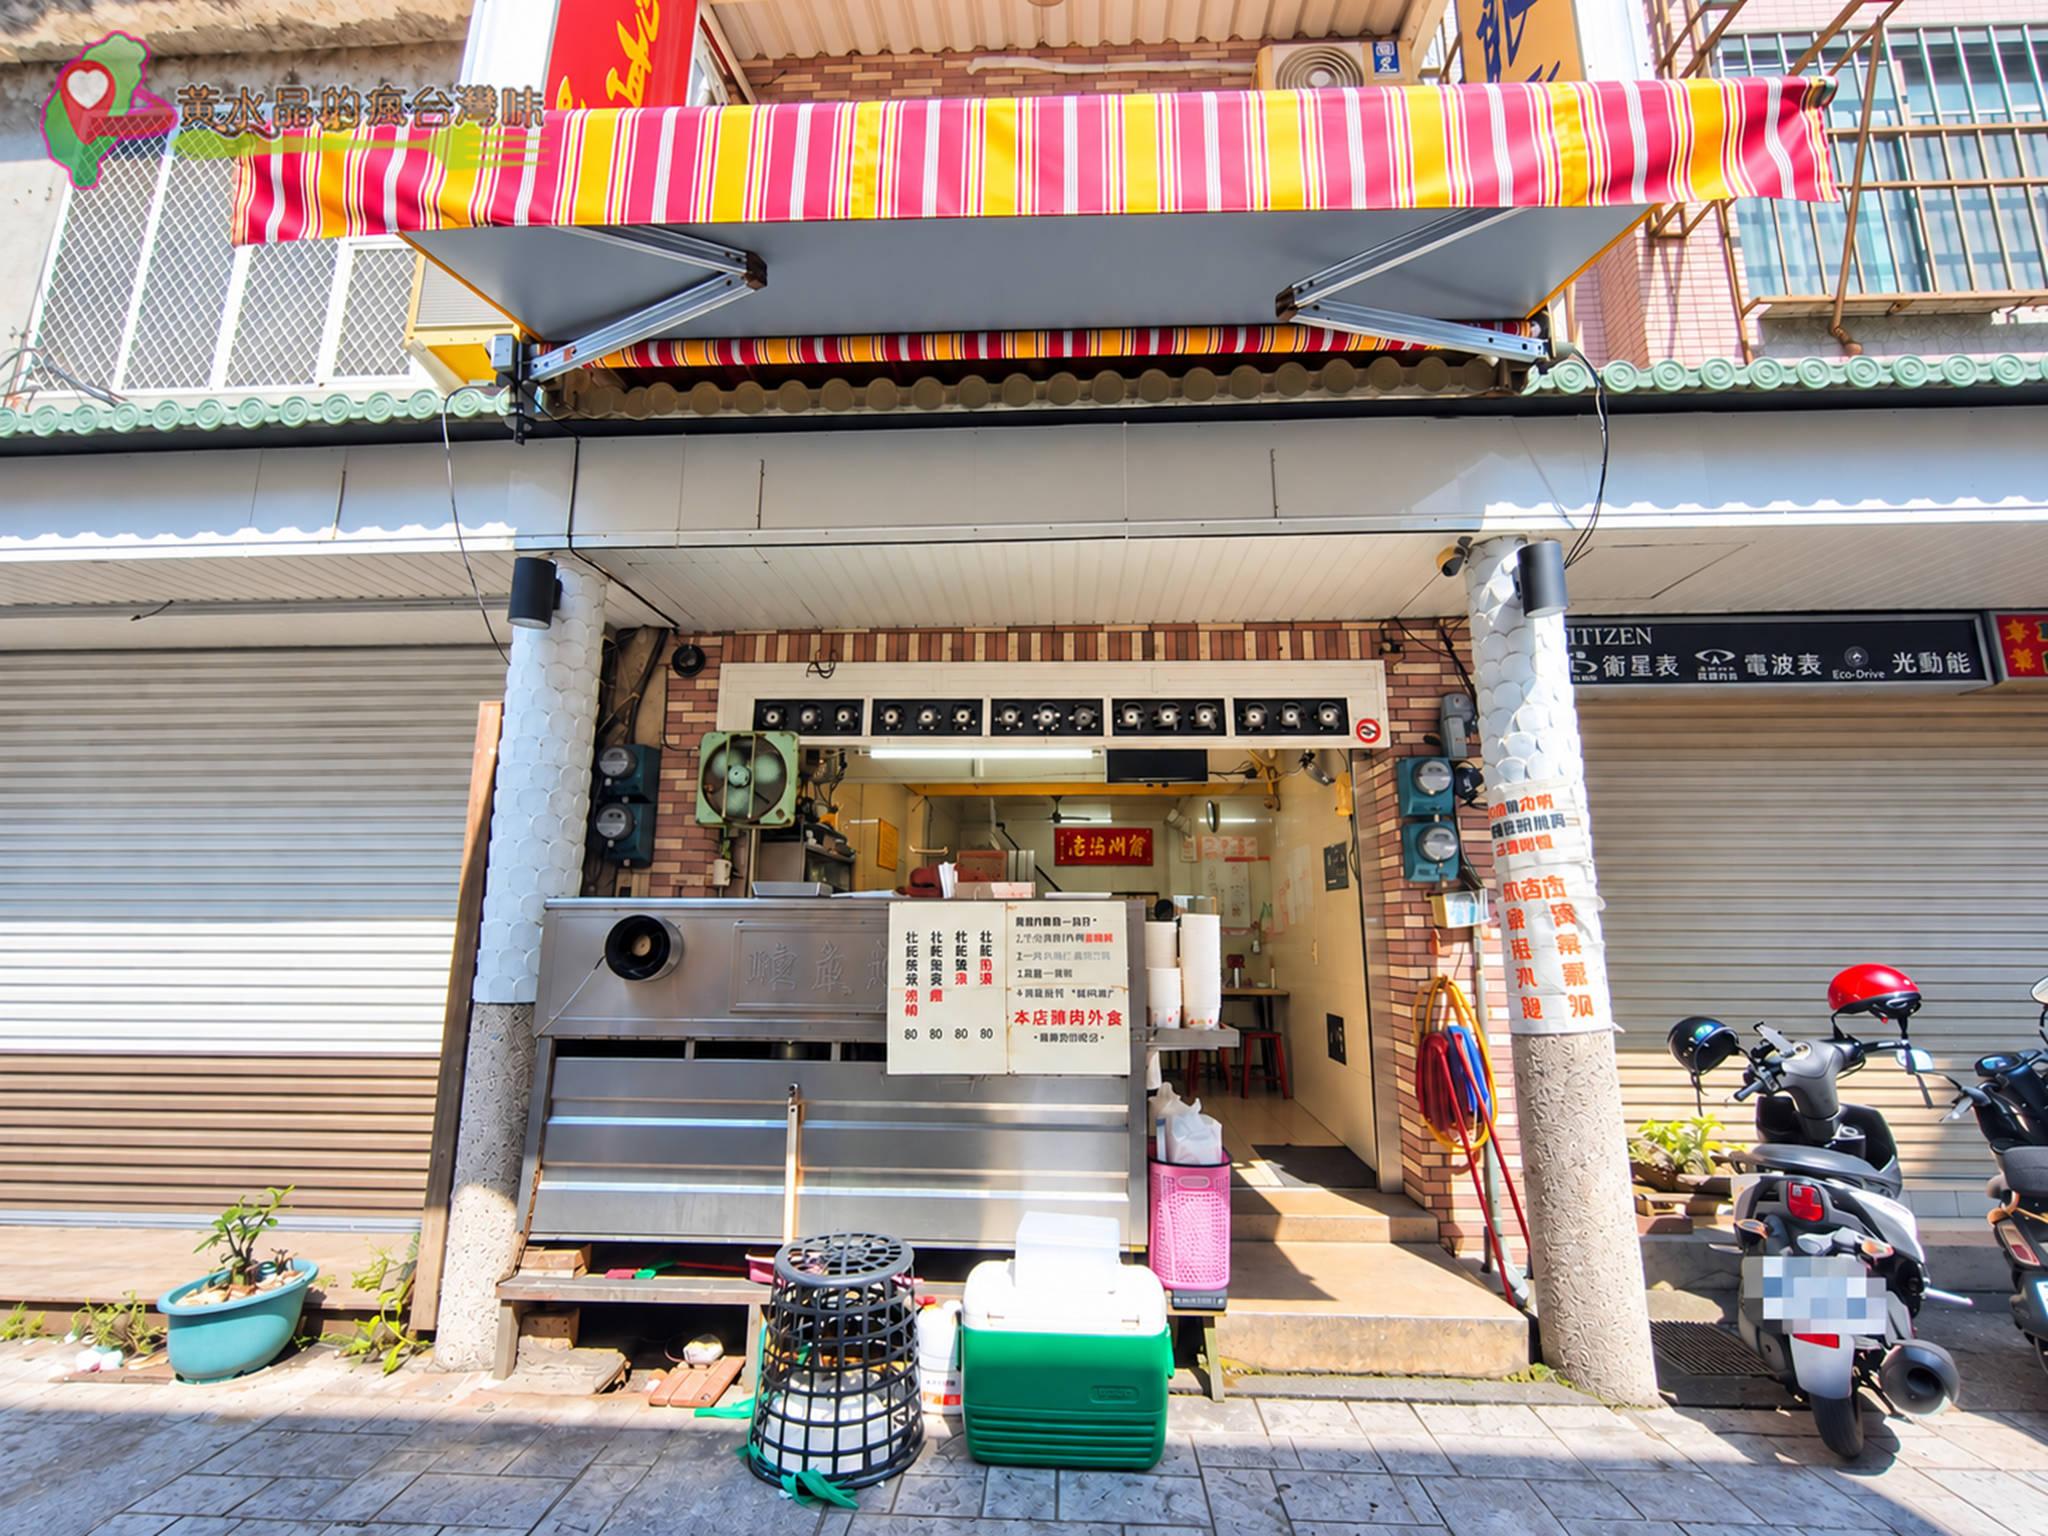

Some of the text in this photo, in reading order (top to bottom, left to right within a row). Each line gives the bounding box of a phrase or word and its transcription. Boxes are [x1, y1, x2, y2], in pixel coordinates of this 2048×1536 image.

[1567, 627, 1652, 646] ITIZEN
[1603, 654, 1679, 677] 衛星表
[1744, 653, 1822, 676] 電波表
[1892, 651, 1971, 674] 光動能
[1832, 669, 1886, 681] Eco-Drive
[904, 1028, 918, 1040] 80
[929, 1028, 943, 1040] 80
[954, 1028, 968, 1039] 80
[980, 1028, 993, 1039] 80
